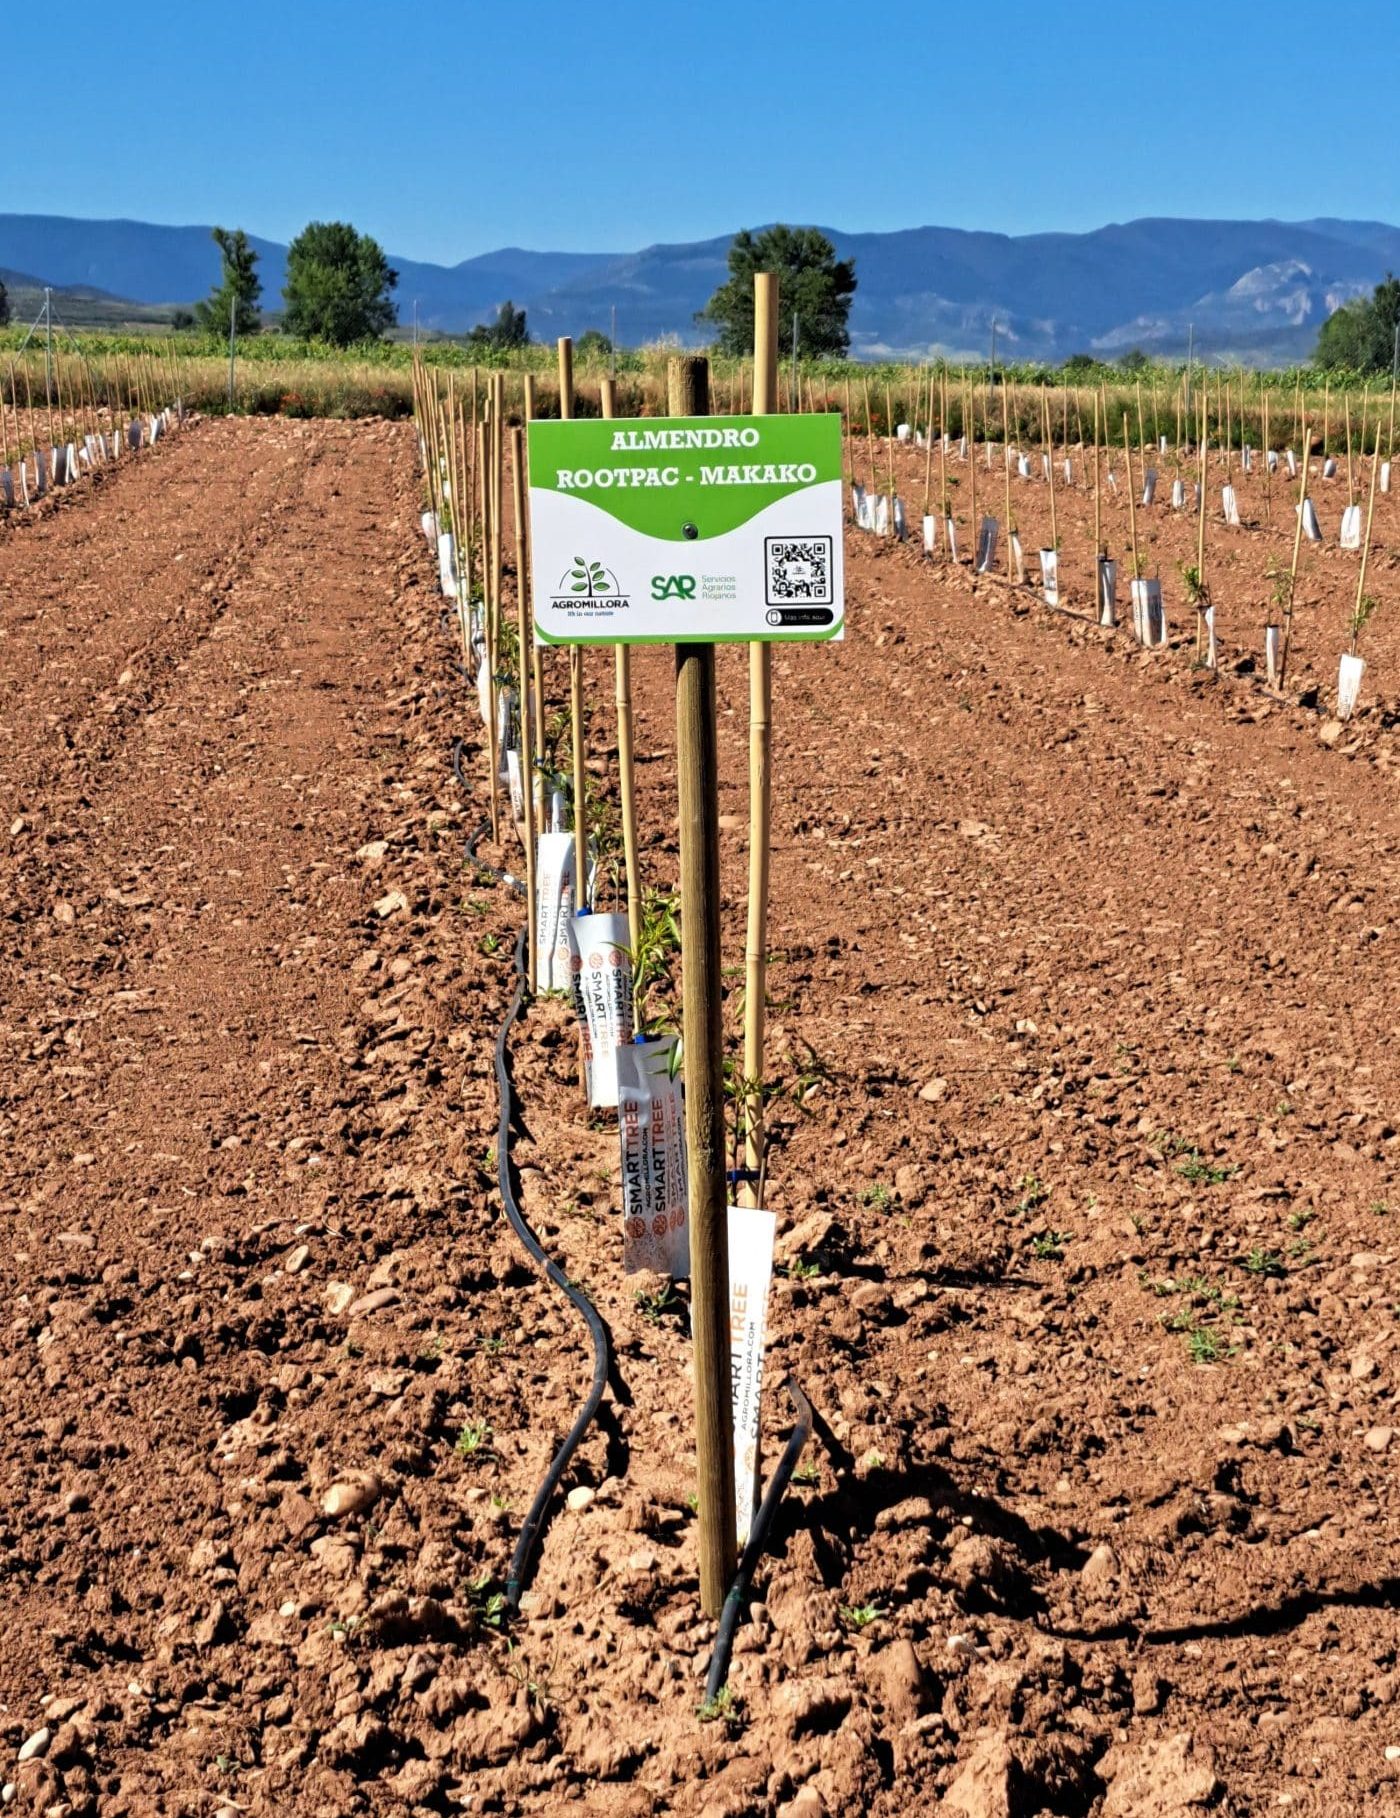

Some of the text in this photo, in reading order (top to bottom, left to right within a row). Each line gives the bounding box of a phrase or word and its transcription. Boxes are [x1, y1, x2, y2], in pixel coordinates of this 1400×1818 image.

[610, 427, 760, 451] ALMENDRO
[556, 466, 679, 489] ROOTPAC
[700, 463, 817, 486] MAKAKO
[650, 574, 697, 601] SAR
[551, 599, 630, 609] AGROMILLORA
[740, 1321, 756, 1431] AGROMILLORA.COM
